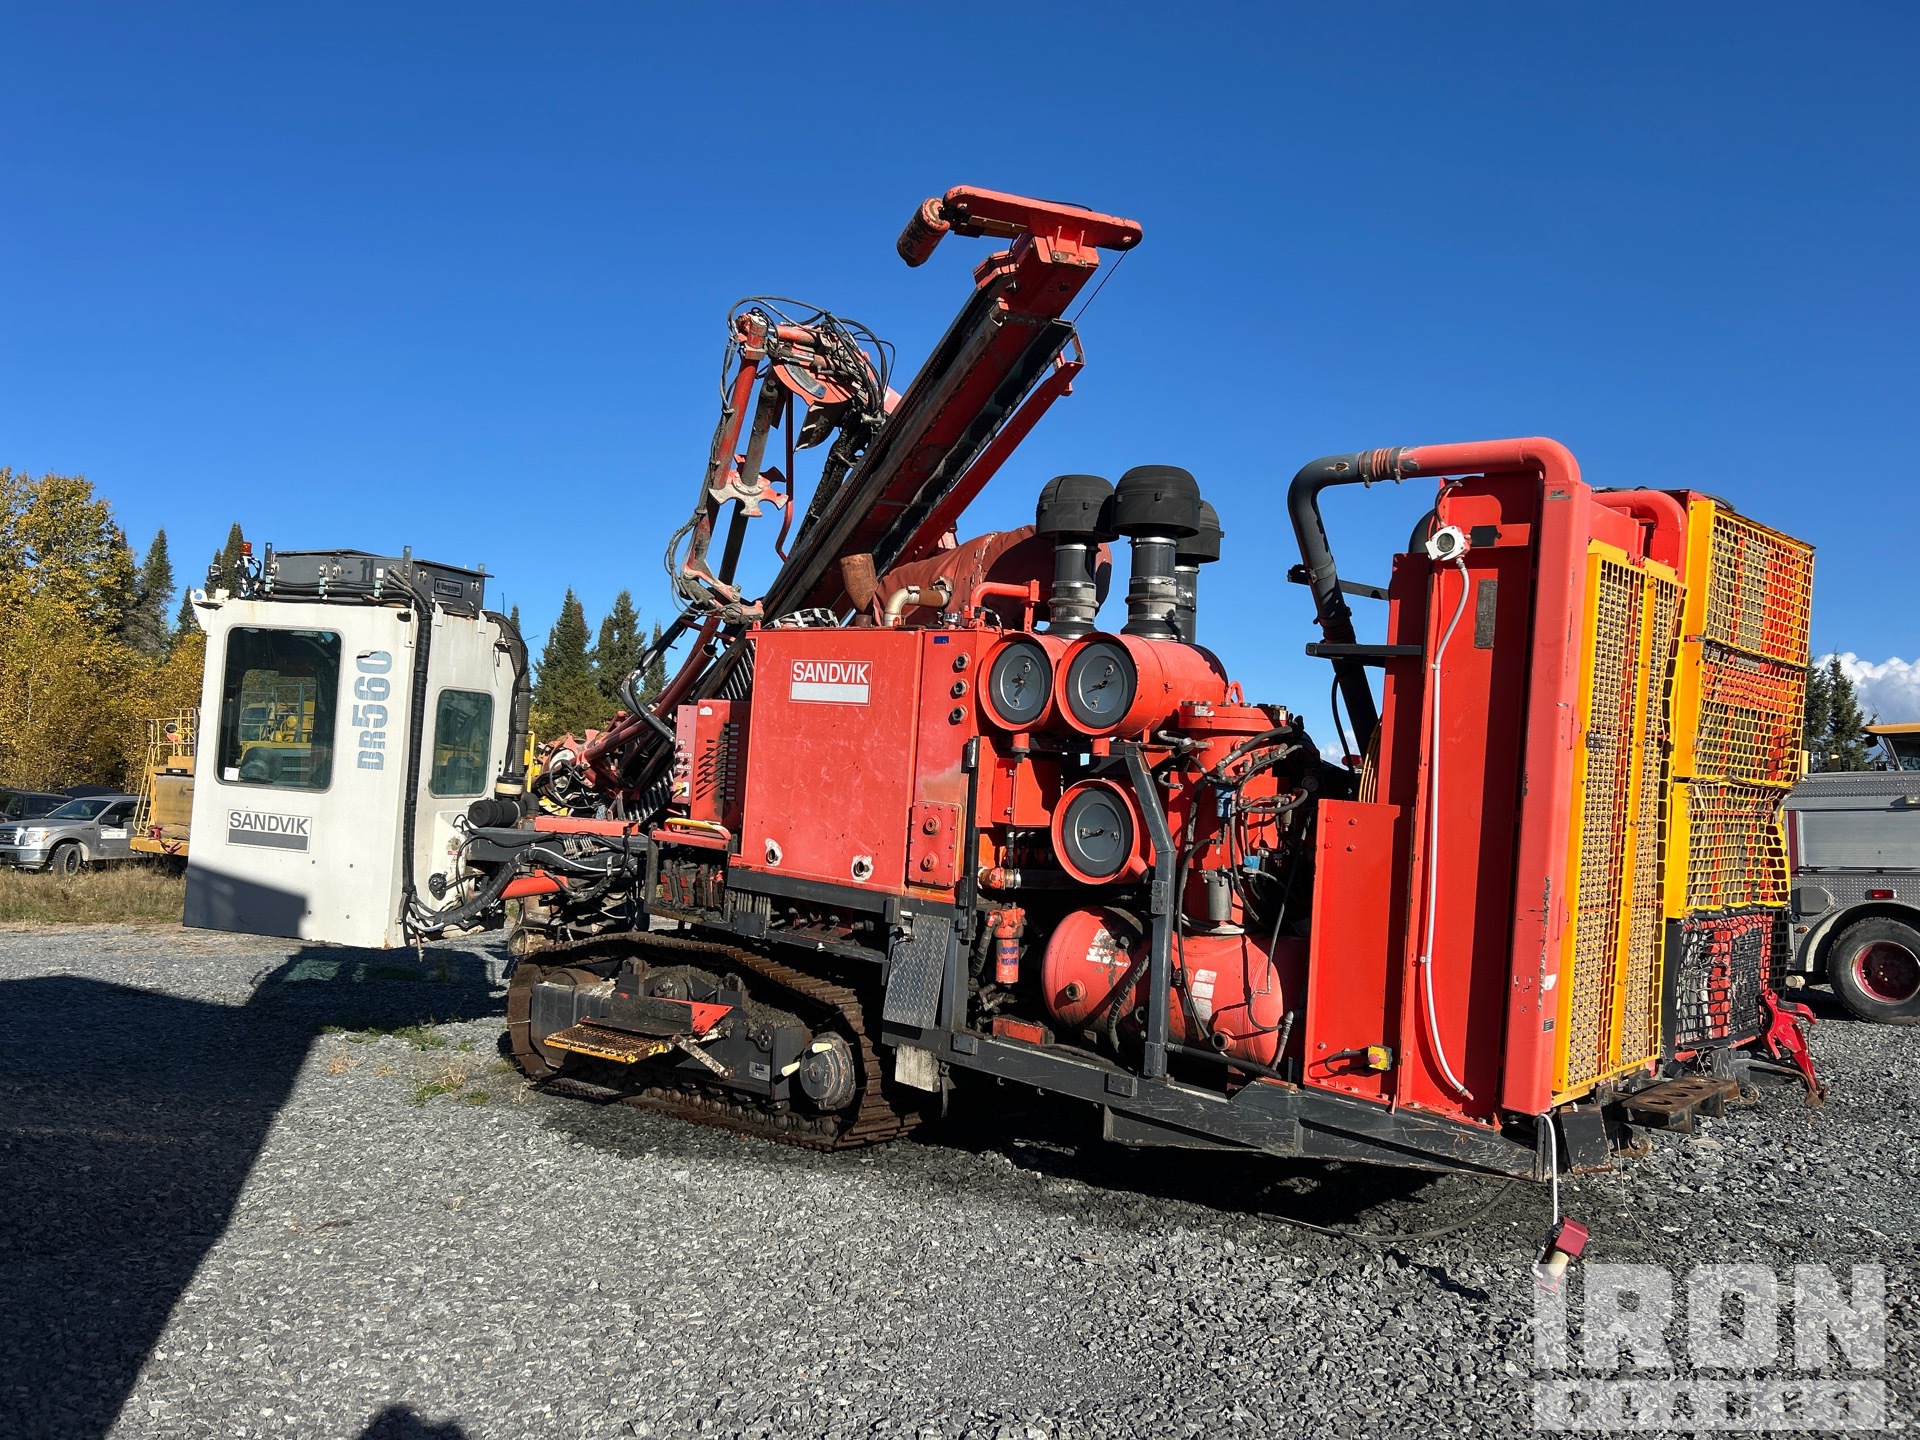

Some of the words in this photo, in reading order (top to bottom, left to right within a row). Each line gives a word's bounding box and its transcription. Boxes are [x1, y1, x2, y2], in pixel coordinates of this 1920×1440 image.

[793, 661, 869, 684] SANDVIK
[352, 650, 392, 771] DR560
[229, 811, 309, 835] SANDVIK
